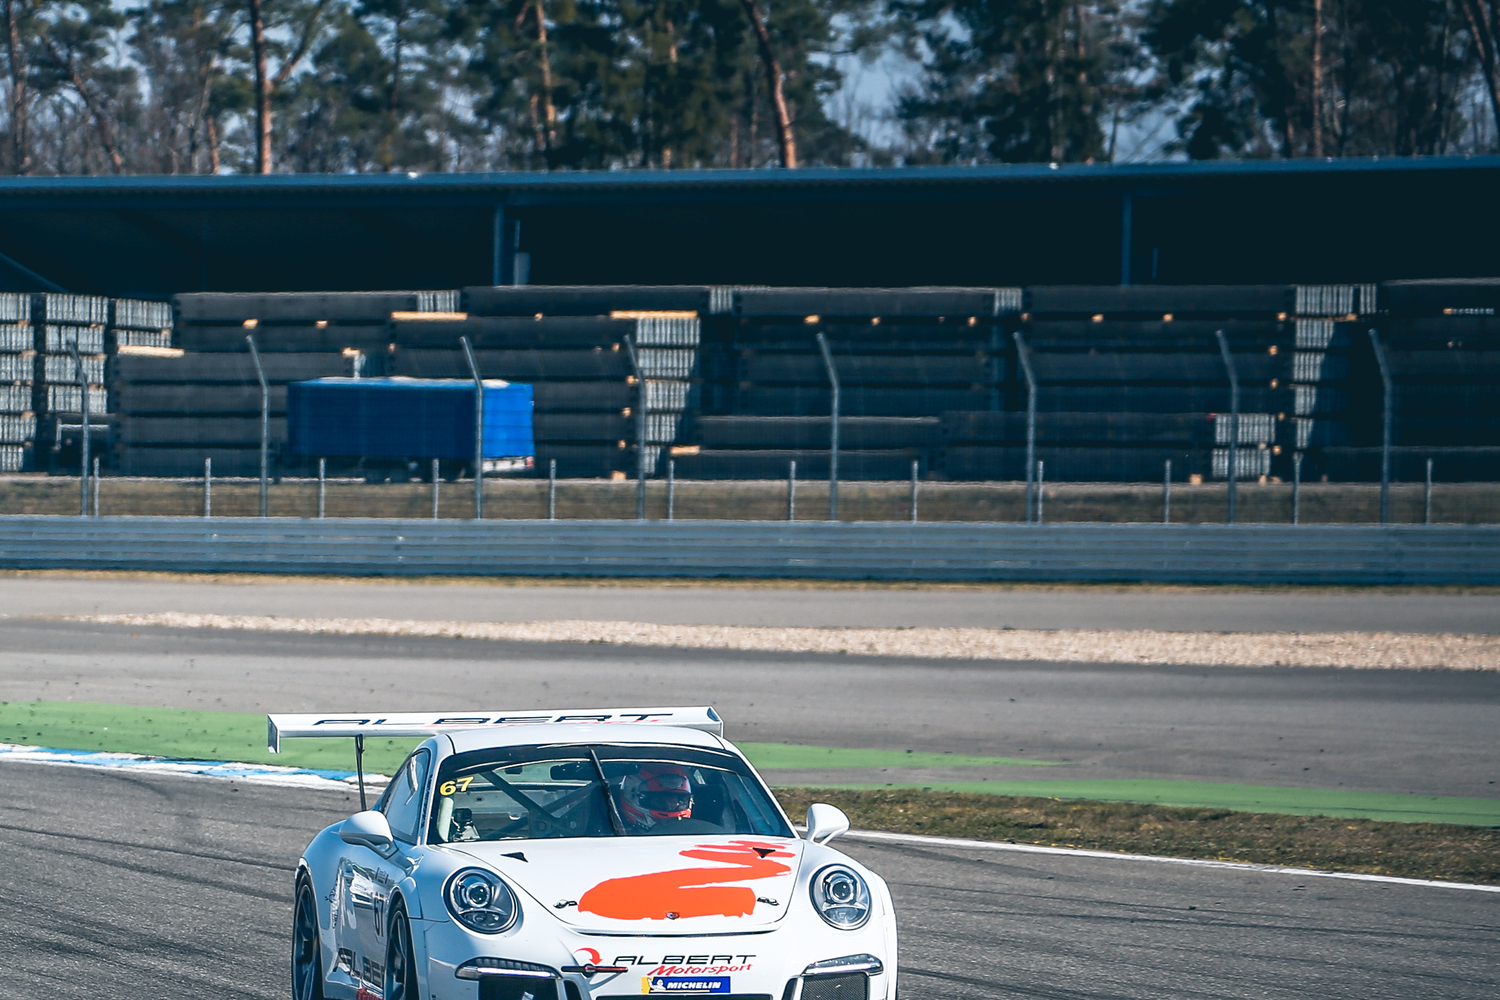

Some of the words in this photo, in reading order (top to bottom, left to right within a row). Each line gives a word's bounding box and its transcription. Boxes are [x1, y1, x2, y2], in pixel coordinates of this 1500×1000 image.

[313, 713, 674, 725] ALBERT
[440, 776, 474, 796] 67
[373, 897, 384, 937] 67
[613, 955, 757, 966] ALBERT
[647, 963, 754, 977] Motorsport
[666, 981, 722, 989] MICHELIN
